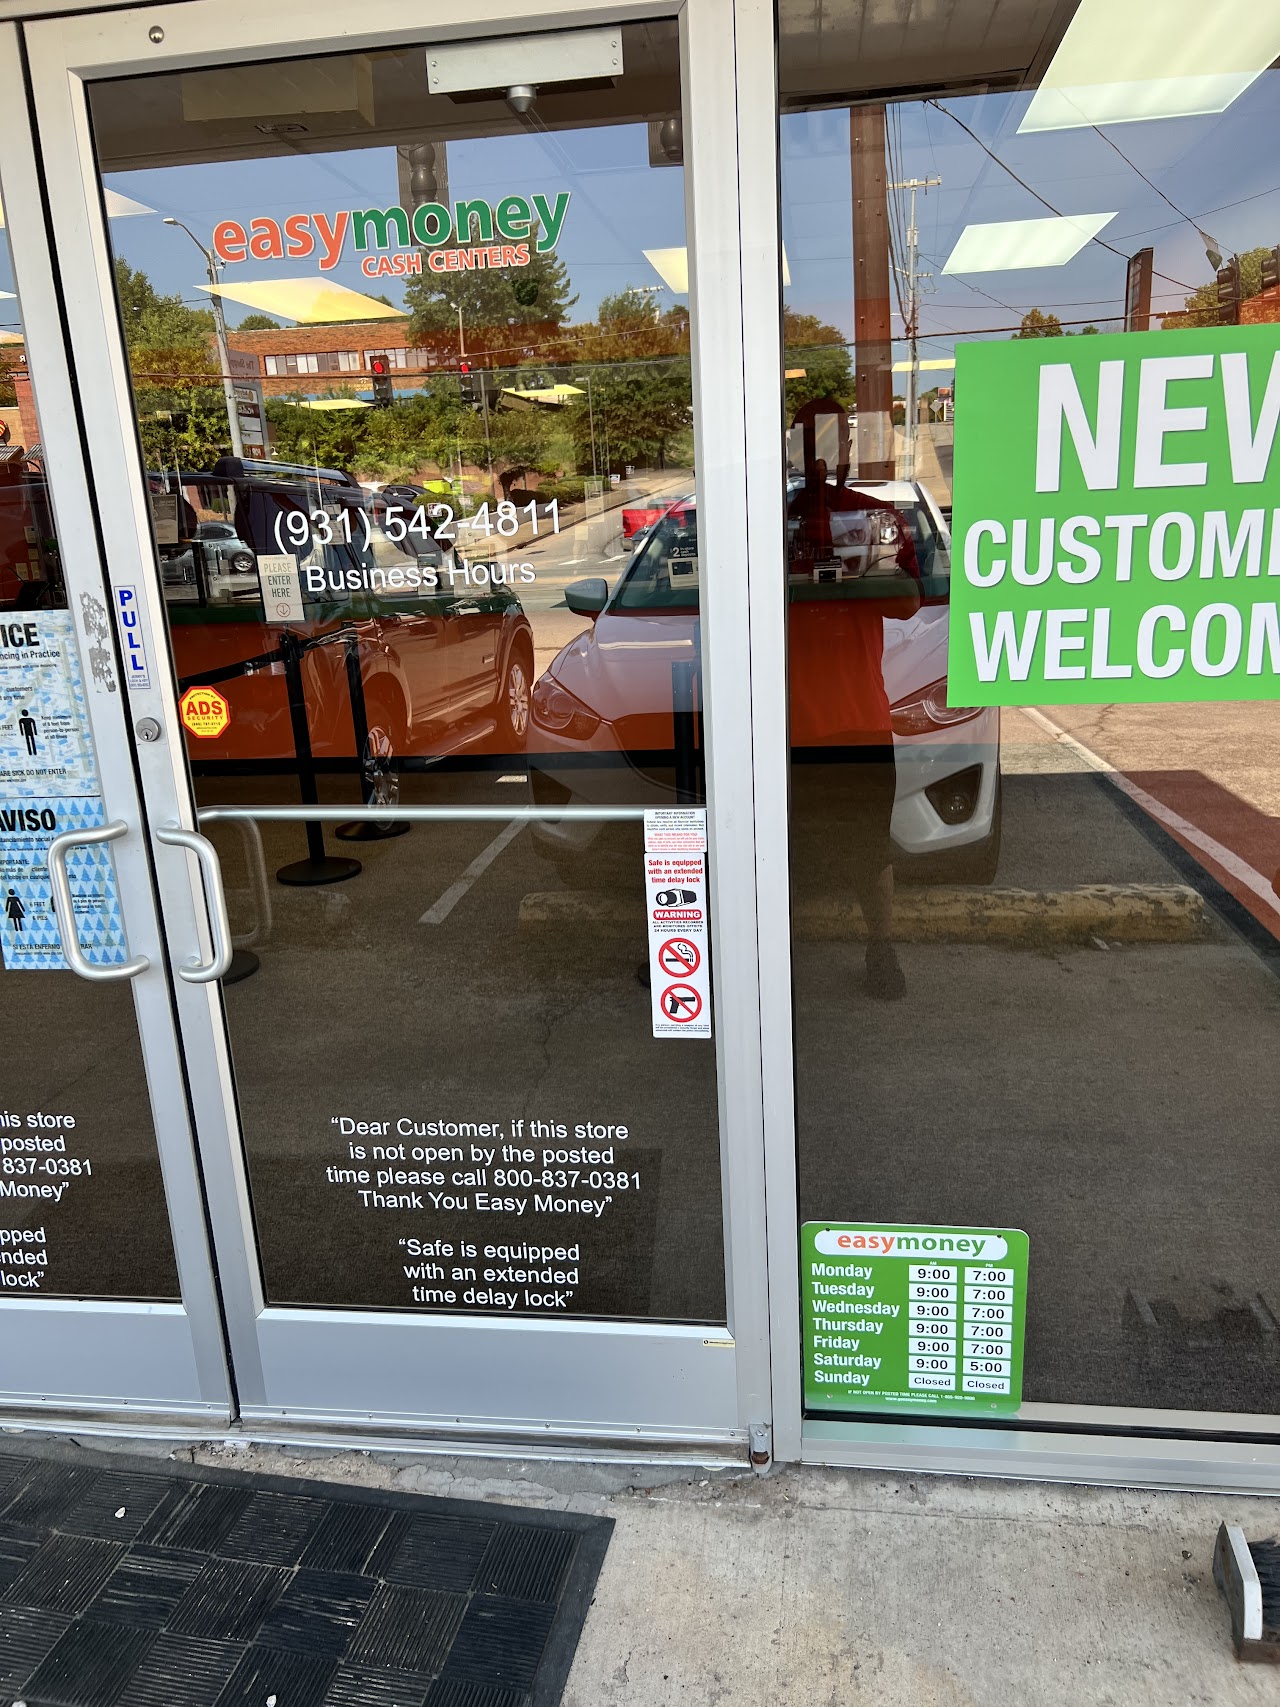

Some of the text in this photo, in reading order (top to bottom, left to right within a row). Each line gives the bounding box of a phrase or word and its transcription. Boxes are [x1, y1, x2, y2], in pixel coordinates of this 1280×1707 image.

[212, 191, 573, 272] easymoney
[361, 243, 531, 279] CASH CENTERS
[274, 498, 560, 555] (931) 542-4811
[963, 507, 1280, 589] CUSTOM
[264, 562, 292, 573] PLEASE
[306, 559, 537, 592] Business Hours
[268, 575, 292, 586] ENTER
[272, 588, 292, 598] HERE
[118, 590, 144, 671] PULL
[21, 650, 29, 659] in
[30, 650, 61, 658] Practice
[186, 700, 223, 716] ADS
[36, 768, 47, 776] NOT
[672, 859, 702, 867] equipped
[27, 1111, 76, 1129] store
[396, 1118, 505, 1140] Customer,
[511, 1120, 525, 1137] if
[530, 1120, 568, 1138] this
[574, 1122, 629, 1139] store
[0, 1134, 66, 1154] posted
[349, 1142, 614, 1167] is not open by the posted
[2, 1157, 93, 1176] 837-0381
[326, 1166, 641, 1190] time please call 800-837-0381
[358, 1190, 424, 1210] Thank
[429, 1191, 469, 1211] You
[475, 1192, 528, 1216] Easy
[460, 1240, 477, 1258] is
[483, 1242, 581, 1264] equipped
[837, 1234, 987, 1258] easymoney
[403, 1263, 580, 1285] with an extended
[811, 1262, 1006, 1282] Monday 9:00 7:00
[412, 1285, 457, 1304] time
[463, 1287, 519, 1309] delay
[811, 1281, 1006, 1301] Tuesday 9:00 7:00
[812, 1299, 1005, 1319] Wednesday 9:00 7:00
[813, 1318, 1004, 1338] Thursday 9:00 7:00
[813, 1335, 1004, 1355] Friday 9:00 7:00
[813, 1352, 1003, 1373] Saturday 9:00 5:00
[814, 1370, 1005, 1390] Sunday Closed Closed
